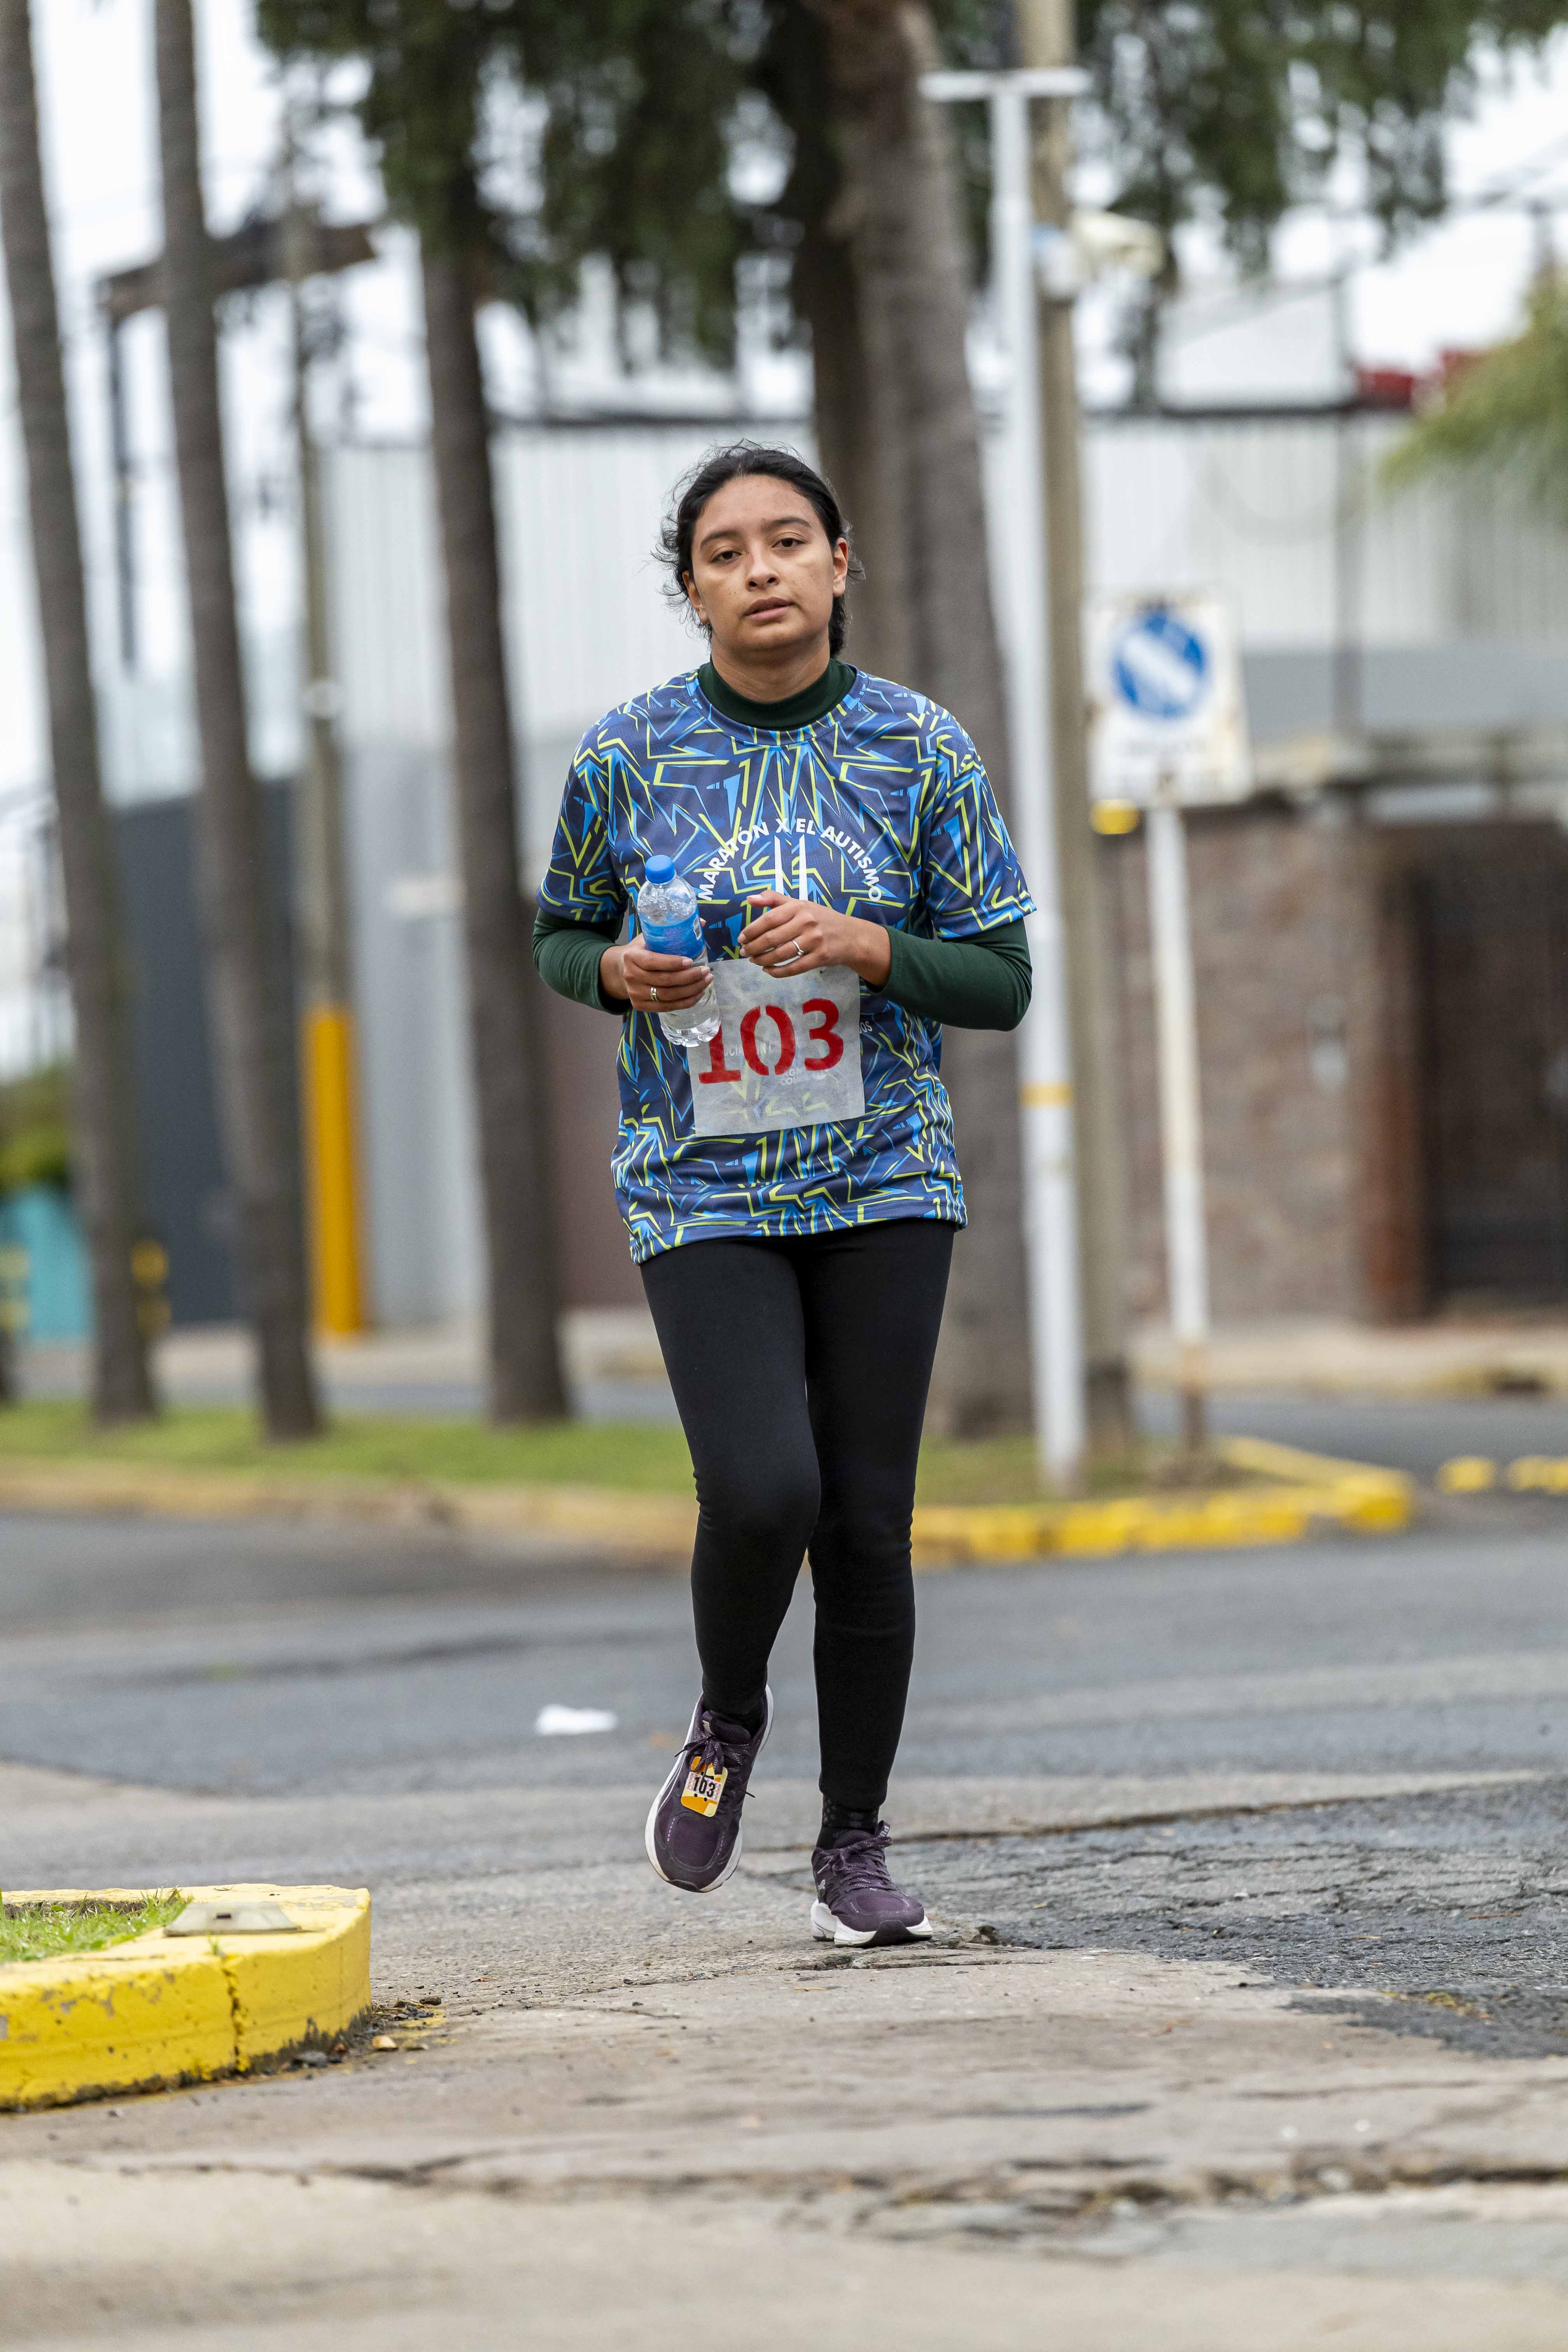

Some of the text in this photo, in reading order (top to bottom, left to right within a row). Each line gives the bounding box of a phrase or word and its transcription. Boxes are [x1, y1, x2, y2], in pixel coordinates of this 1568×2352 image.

[698, 818, 882, 902] MARATÓN X EL AUTISMO
[699, 998, 844, 1084] 103
[693, 1776, 716, 1797] 103
